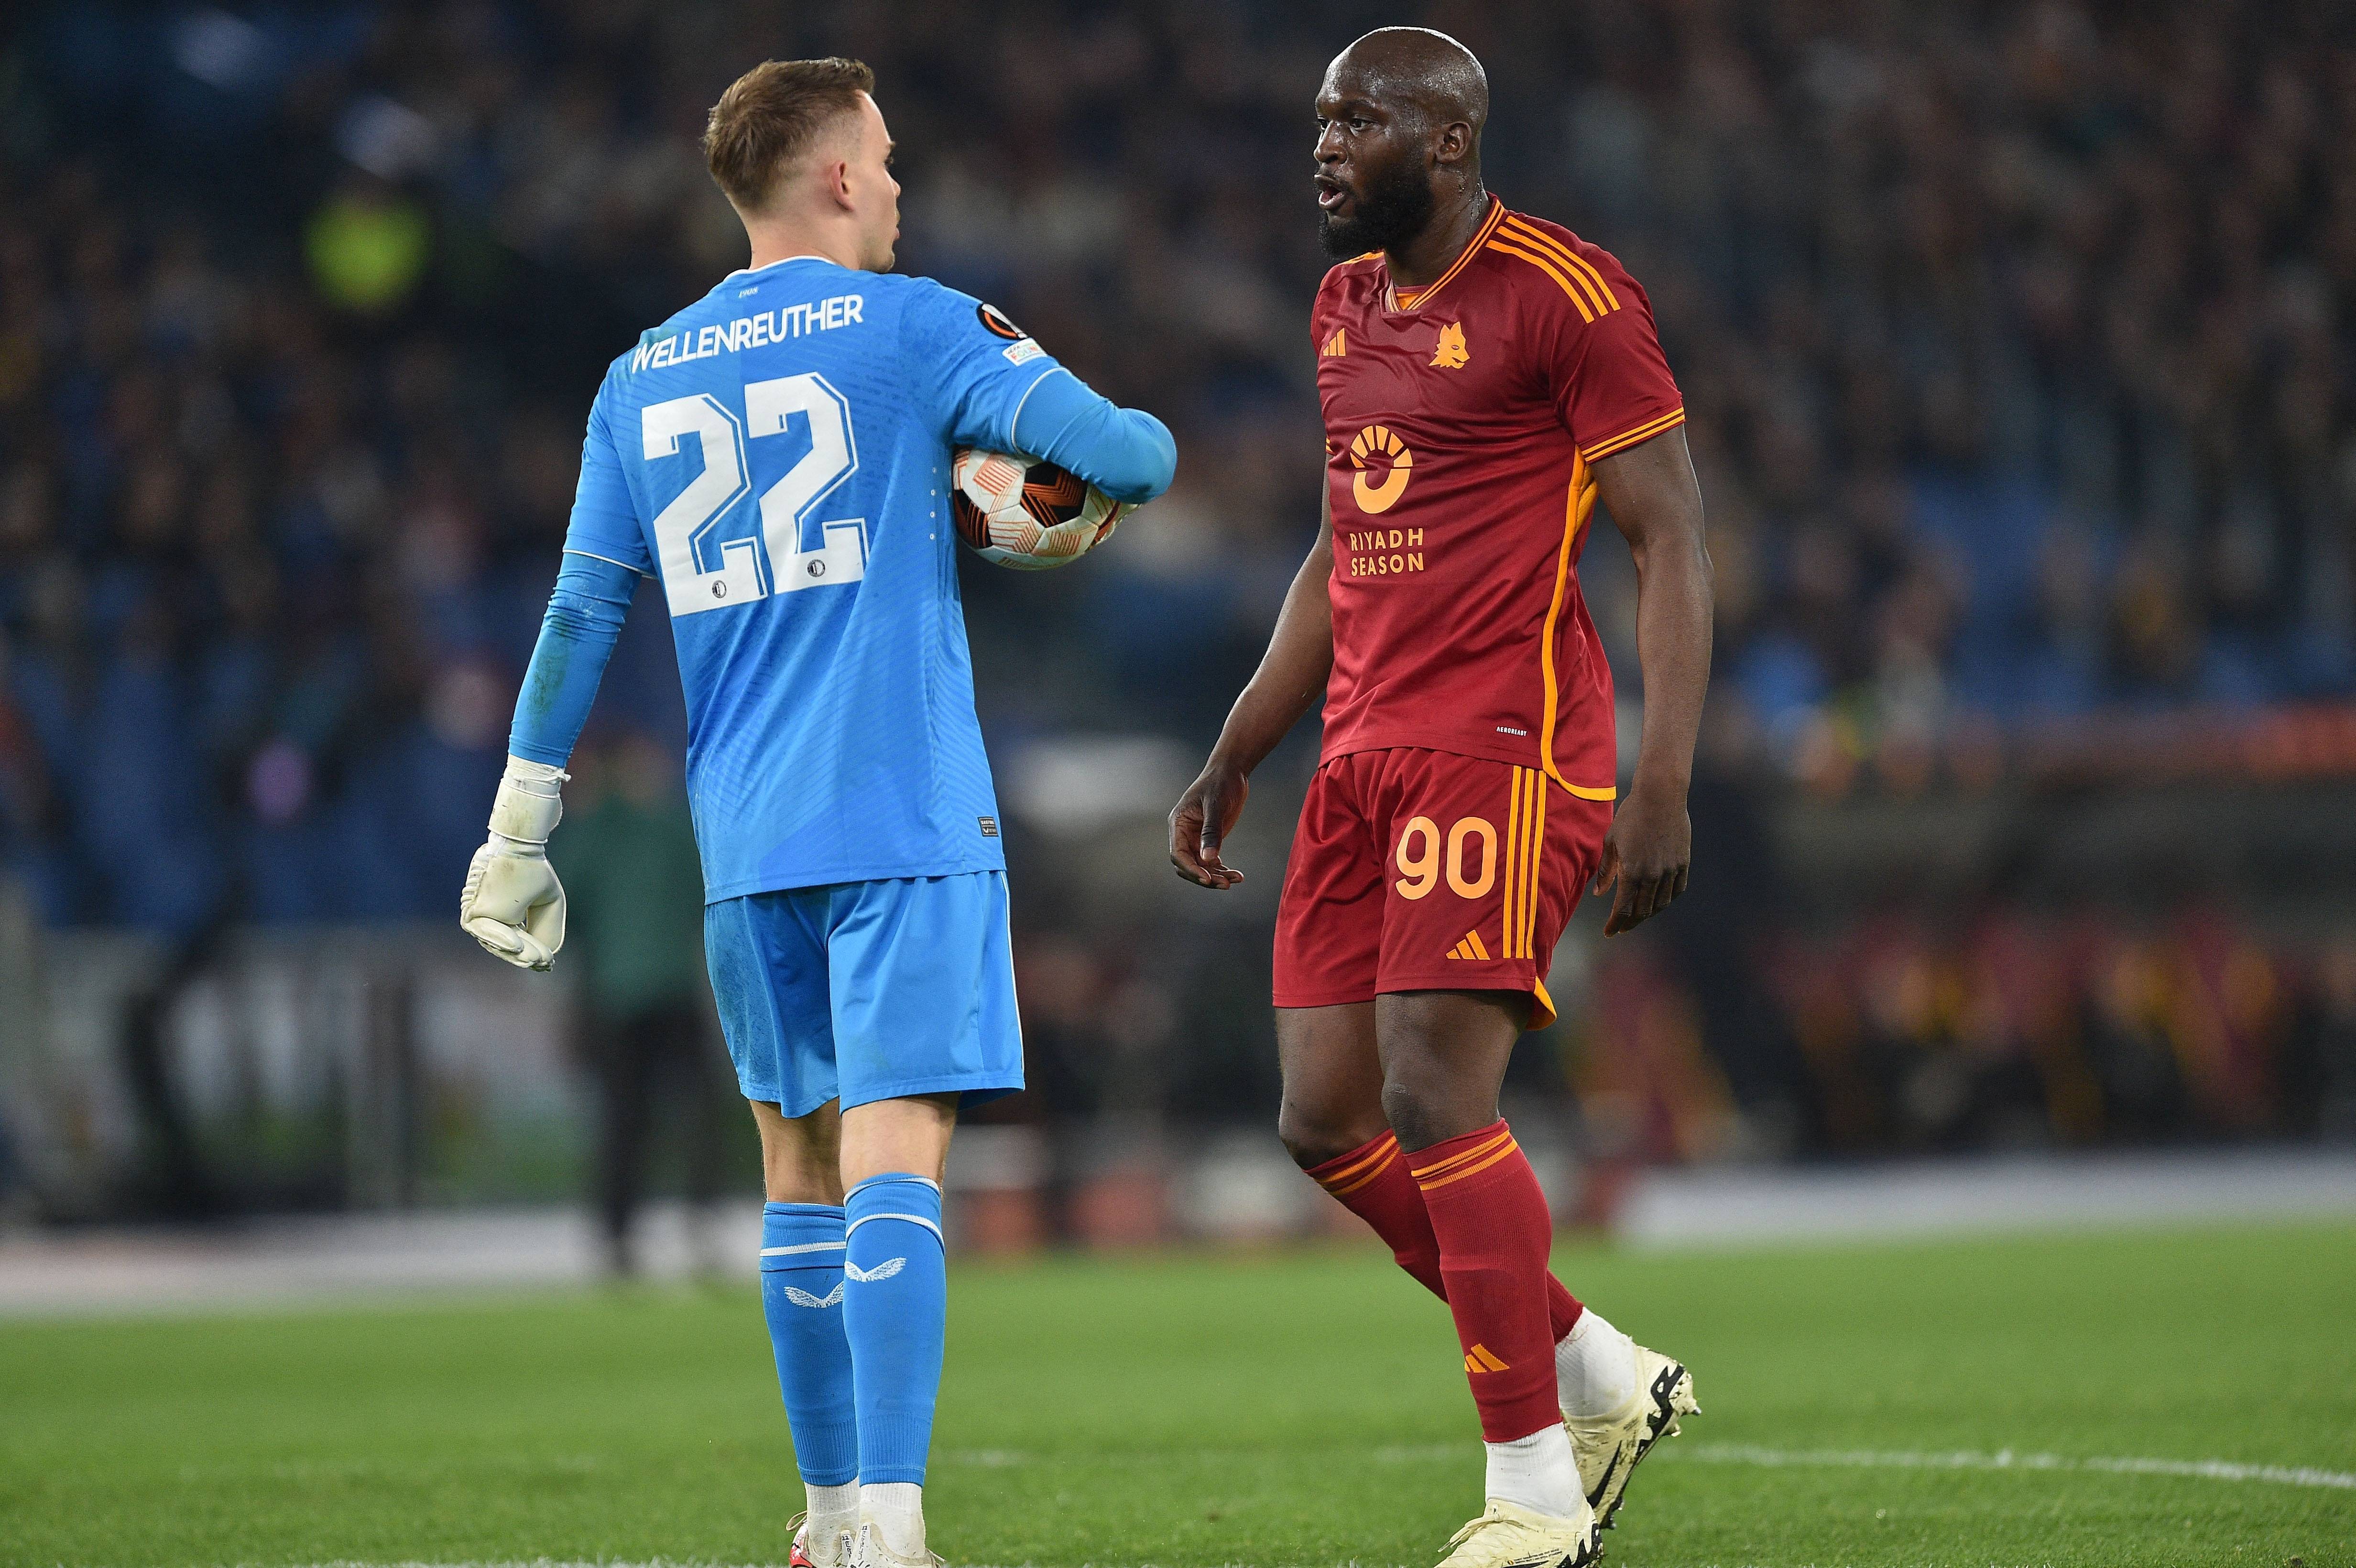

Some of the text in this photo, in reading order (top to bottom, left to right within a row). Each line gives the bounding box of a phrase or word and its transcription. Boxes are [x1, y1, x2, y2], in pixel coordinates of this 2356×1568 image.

[631, 294, 863, 374] WELLENREUTHER
[641, 371, 870, 617] 22
[1349, 528, 1424, 551] RIYADH
[1351, 552, 1424, 577] SEASON
[1496, 726, 1527, 736] AEROREADY
[1395, 816, 1497, 900] 90
